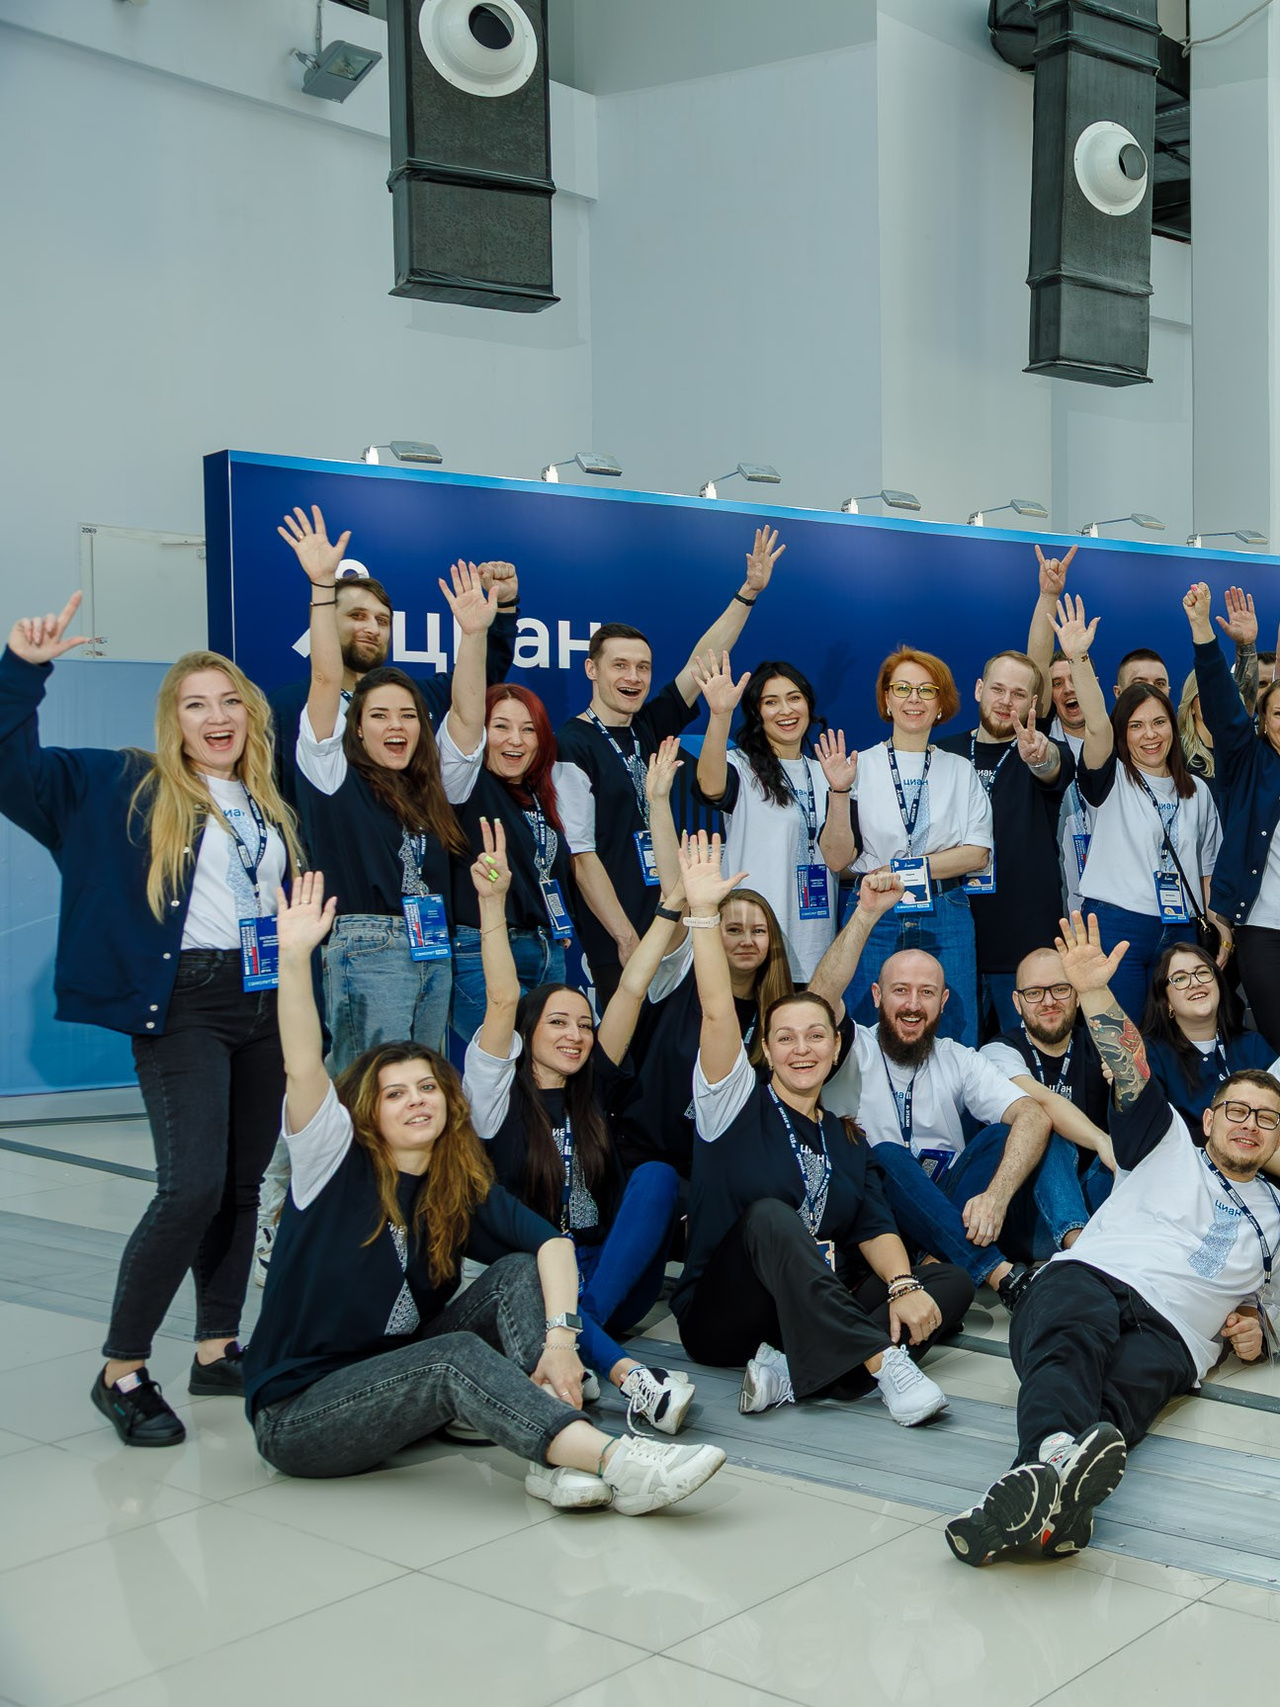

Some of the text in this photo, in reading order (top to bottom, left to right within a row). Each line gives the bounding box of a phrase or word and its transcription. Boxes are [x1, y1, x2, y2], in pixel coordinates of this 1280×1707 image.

[393, 611, 602, 673] цан
[1049, 1084, 1072, 1093] цан
[1215, 1199, 1242, 1217] циан
